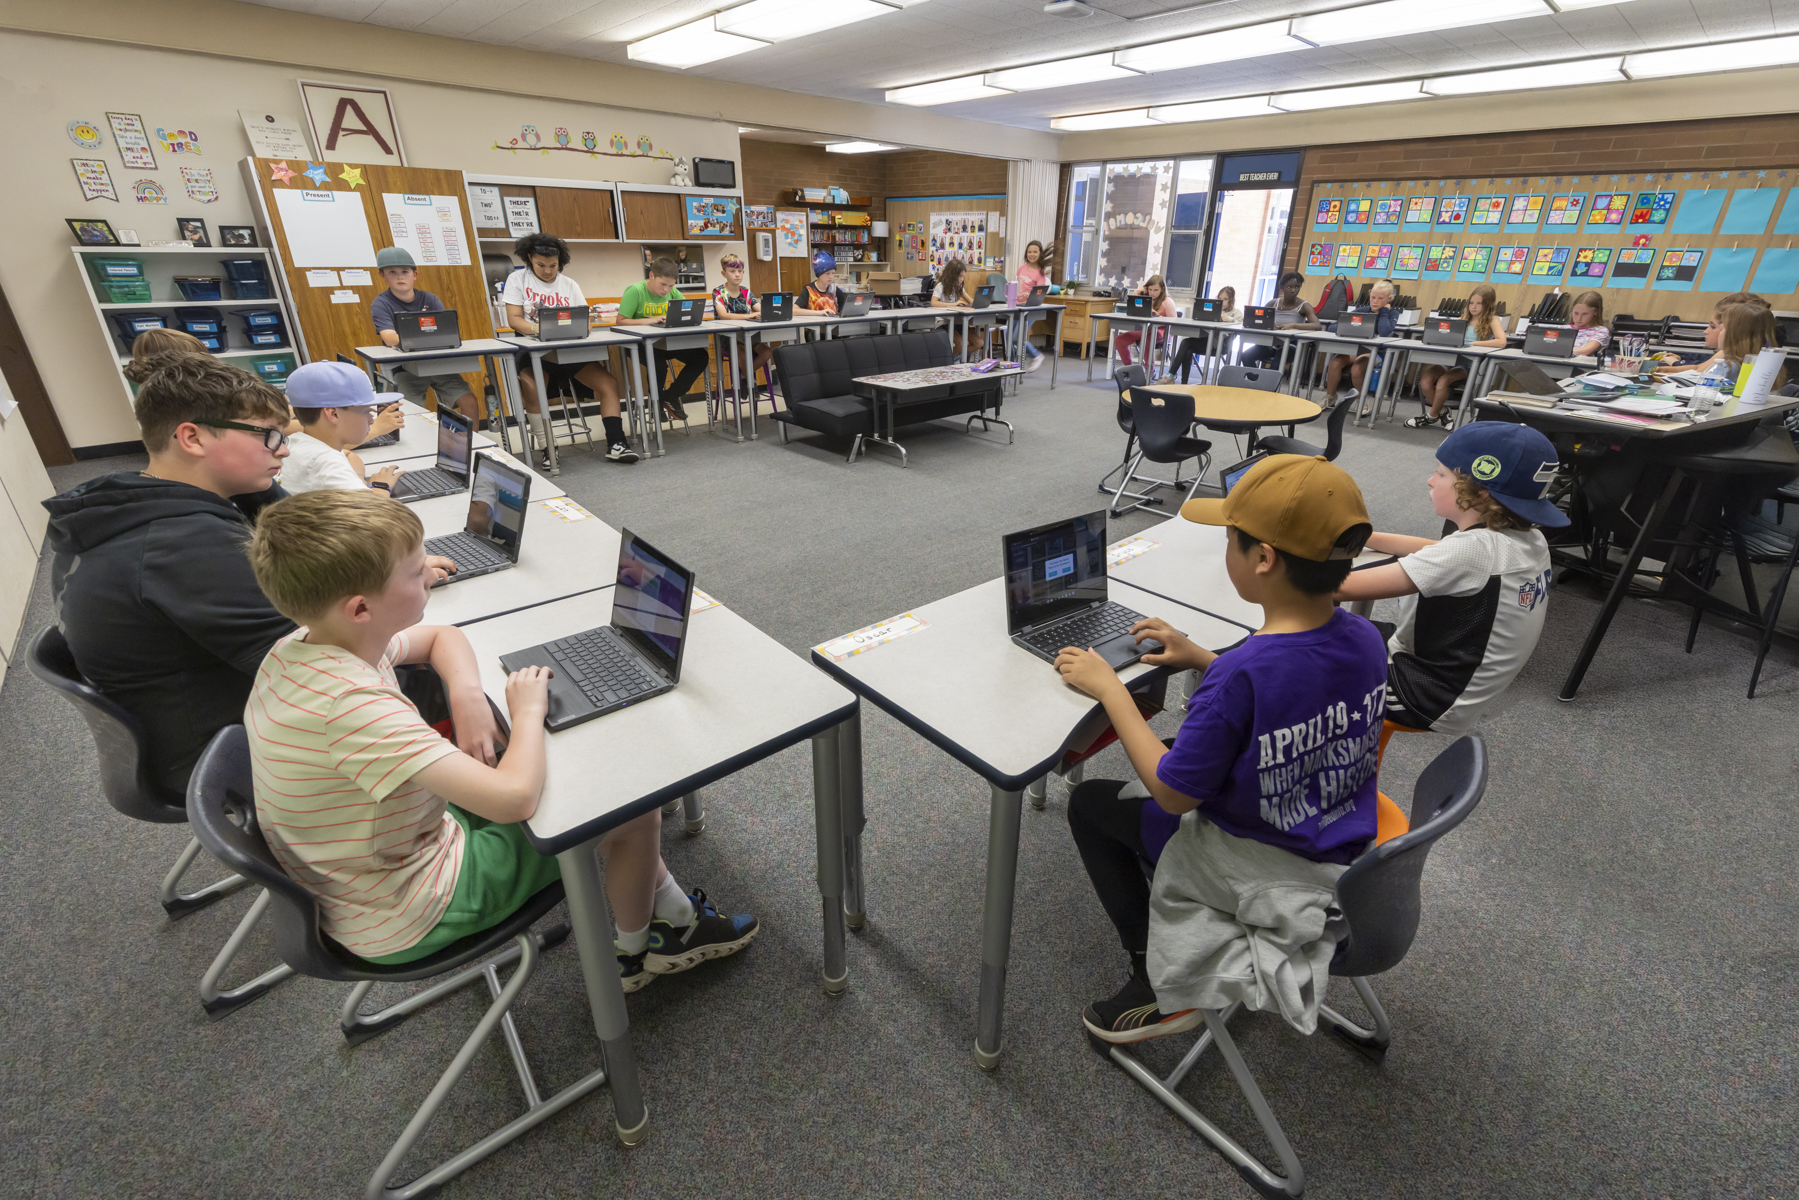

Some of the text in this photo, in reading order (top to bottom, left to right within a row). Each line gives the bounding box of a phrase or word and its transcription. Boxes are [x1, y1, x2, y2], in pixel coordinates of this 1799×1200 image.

[156, 128, 198, 142] GOOD
[160, 140, 201, 153] VIBES
[526, 287, 570, 307] Crooks
[1520, 592, 1533, 605] NFL
[853, 627, 891, 643] Oscar
[1257, 713, 1325, 769] APRIL
[1324, 701, 1348, 738] 19
[1259, 760, 1300, 796] WHEN
[1260, 777, 1318, 832] MADE
